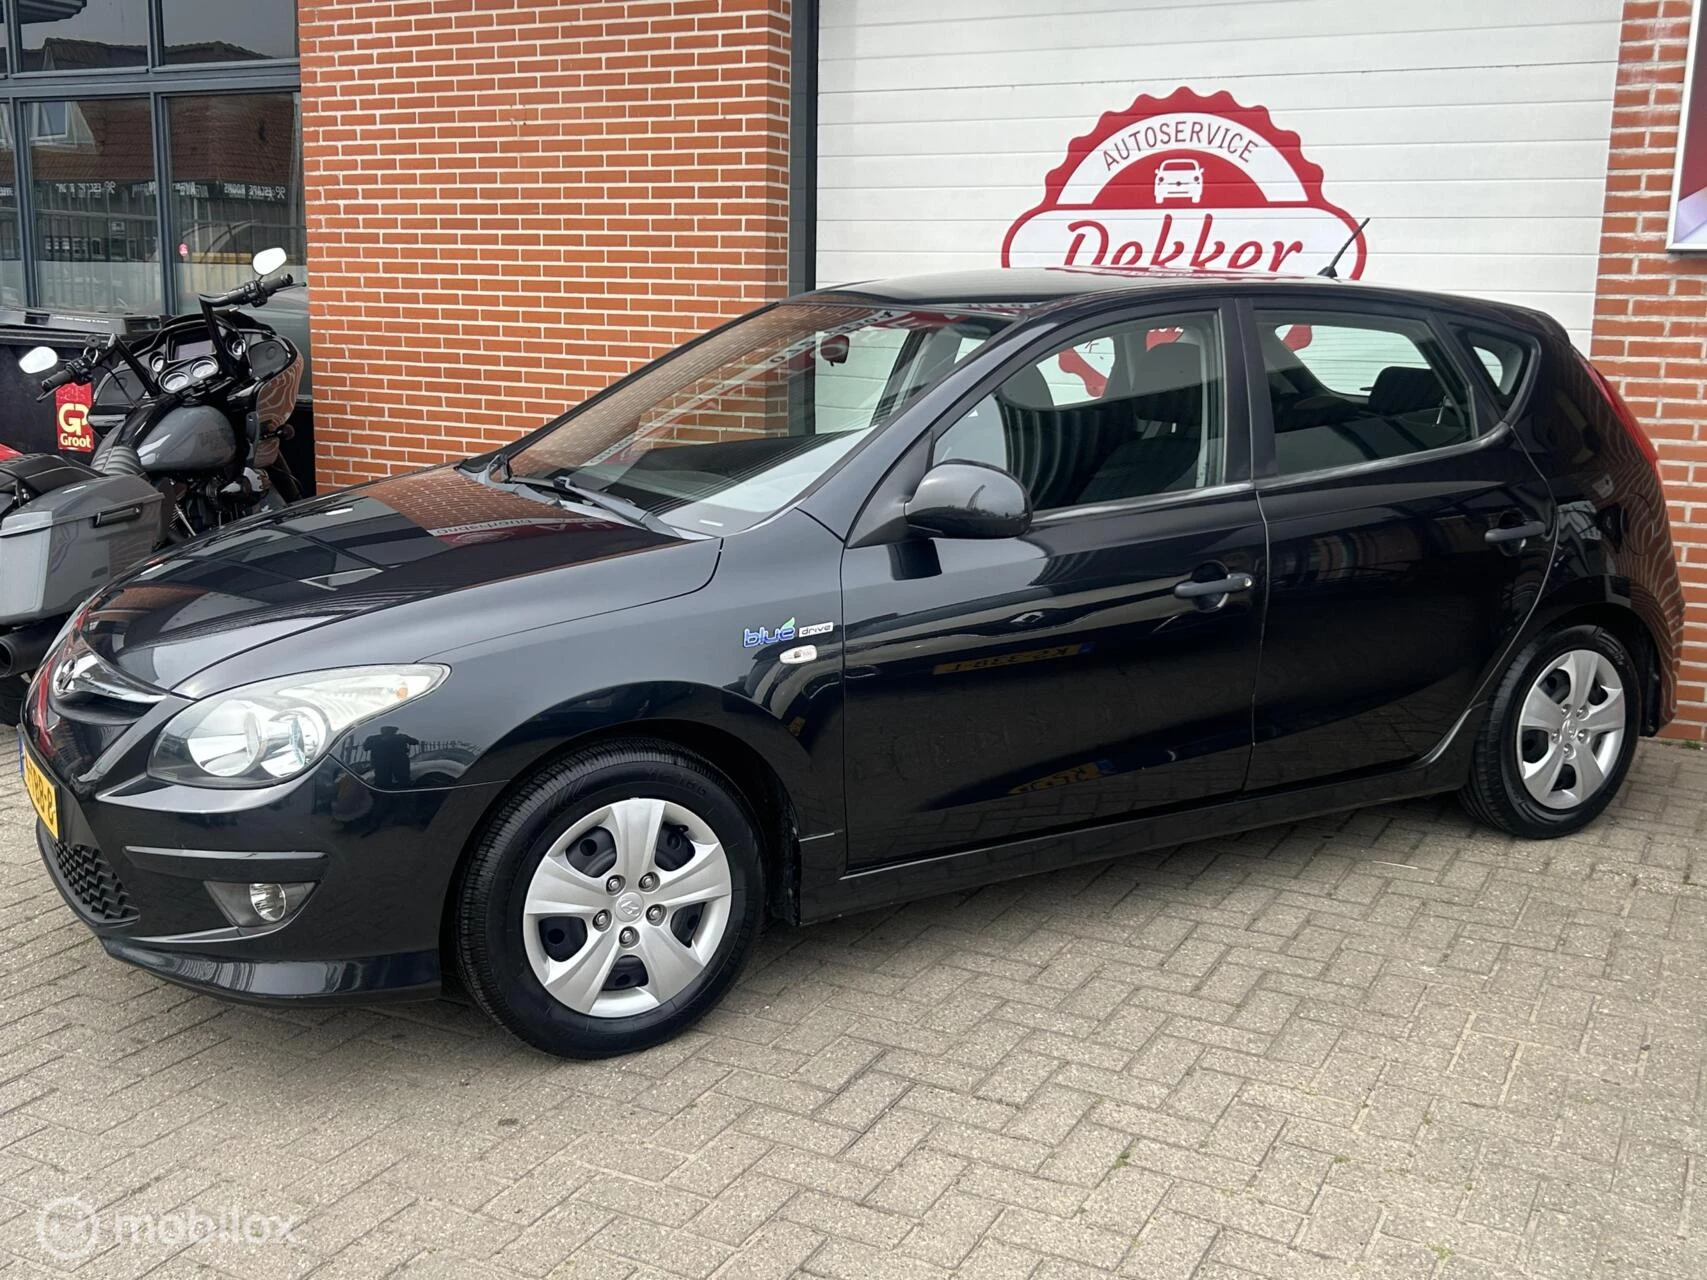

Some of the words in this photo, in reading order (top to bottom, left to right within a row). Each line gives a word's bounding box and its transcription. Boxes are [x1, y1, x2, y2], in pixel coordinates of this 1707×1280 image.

[1103, 121, 1258, 171] AUTOSERVICE
[60, 433, 91, 448] Groot
[744, 625, 795, 647] blue
[801, 624, 832, 636] drive
